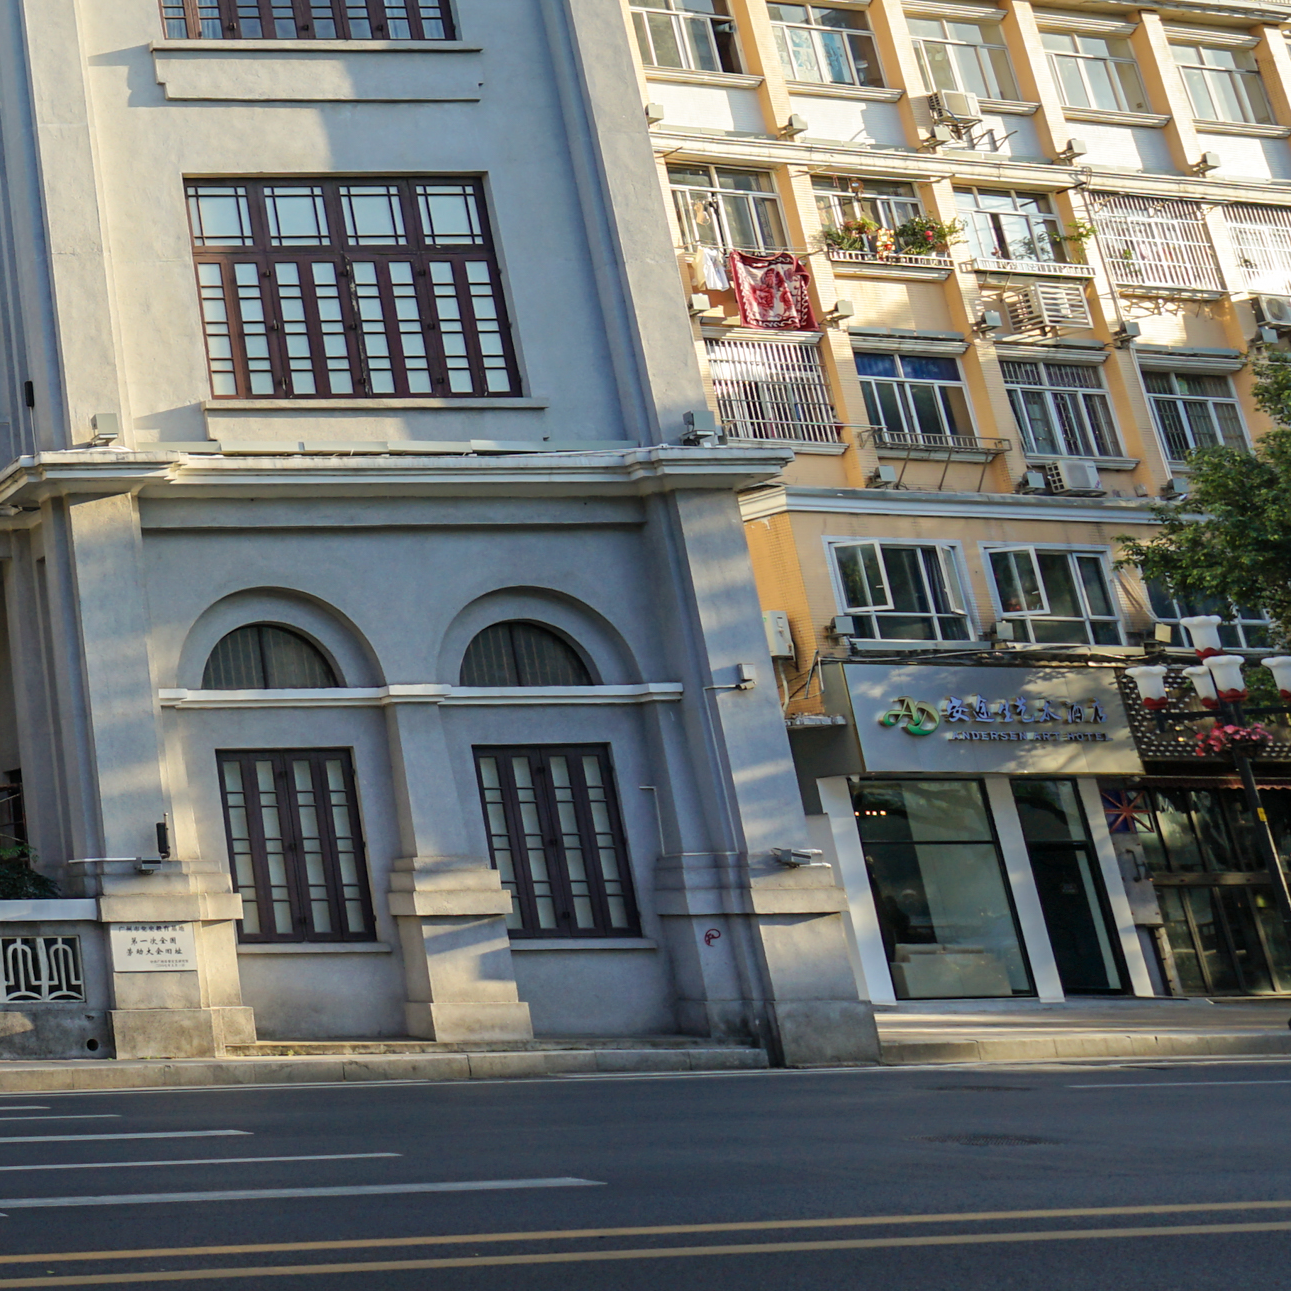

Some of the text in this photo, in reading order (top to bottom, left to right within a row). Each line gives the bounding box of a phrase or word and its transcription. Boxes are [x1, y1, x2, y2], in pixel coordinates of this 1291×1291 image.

[951, 731, 1112, 741] ANDERSEN ART HOTEL
[131, 936, 177, 946] 第一次全国
[126, 947, 183, 957] 劳动大会旧址
